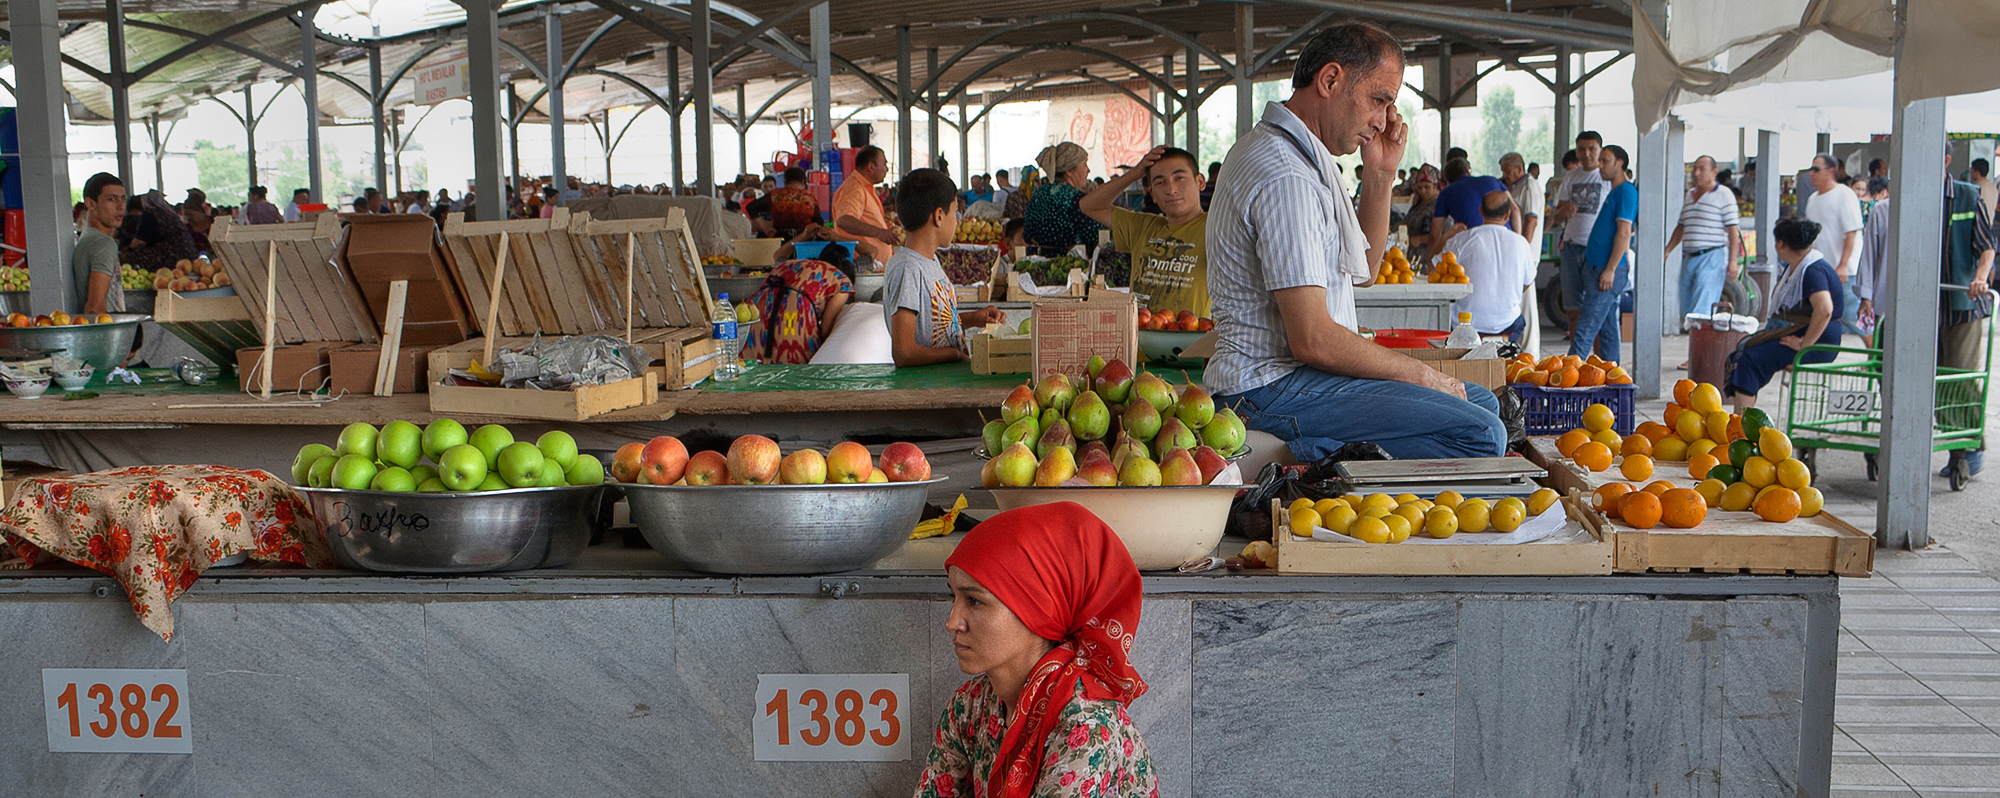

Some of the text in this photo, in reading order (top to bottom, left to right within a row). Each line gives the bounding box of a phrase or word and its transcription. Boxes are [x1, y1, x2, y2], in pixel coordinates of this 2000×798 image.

[1179, 254, 1199, 263] cool
[1833, 394, 1869, 411] J22
[57, 683, 182, 738] 1382
[766, 689, 901, 746] 1383
